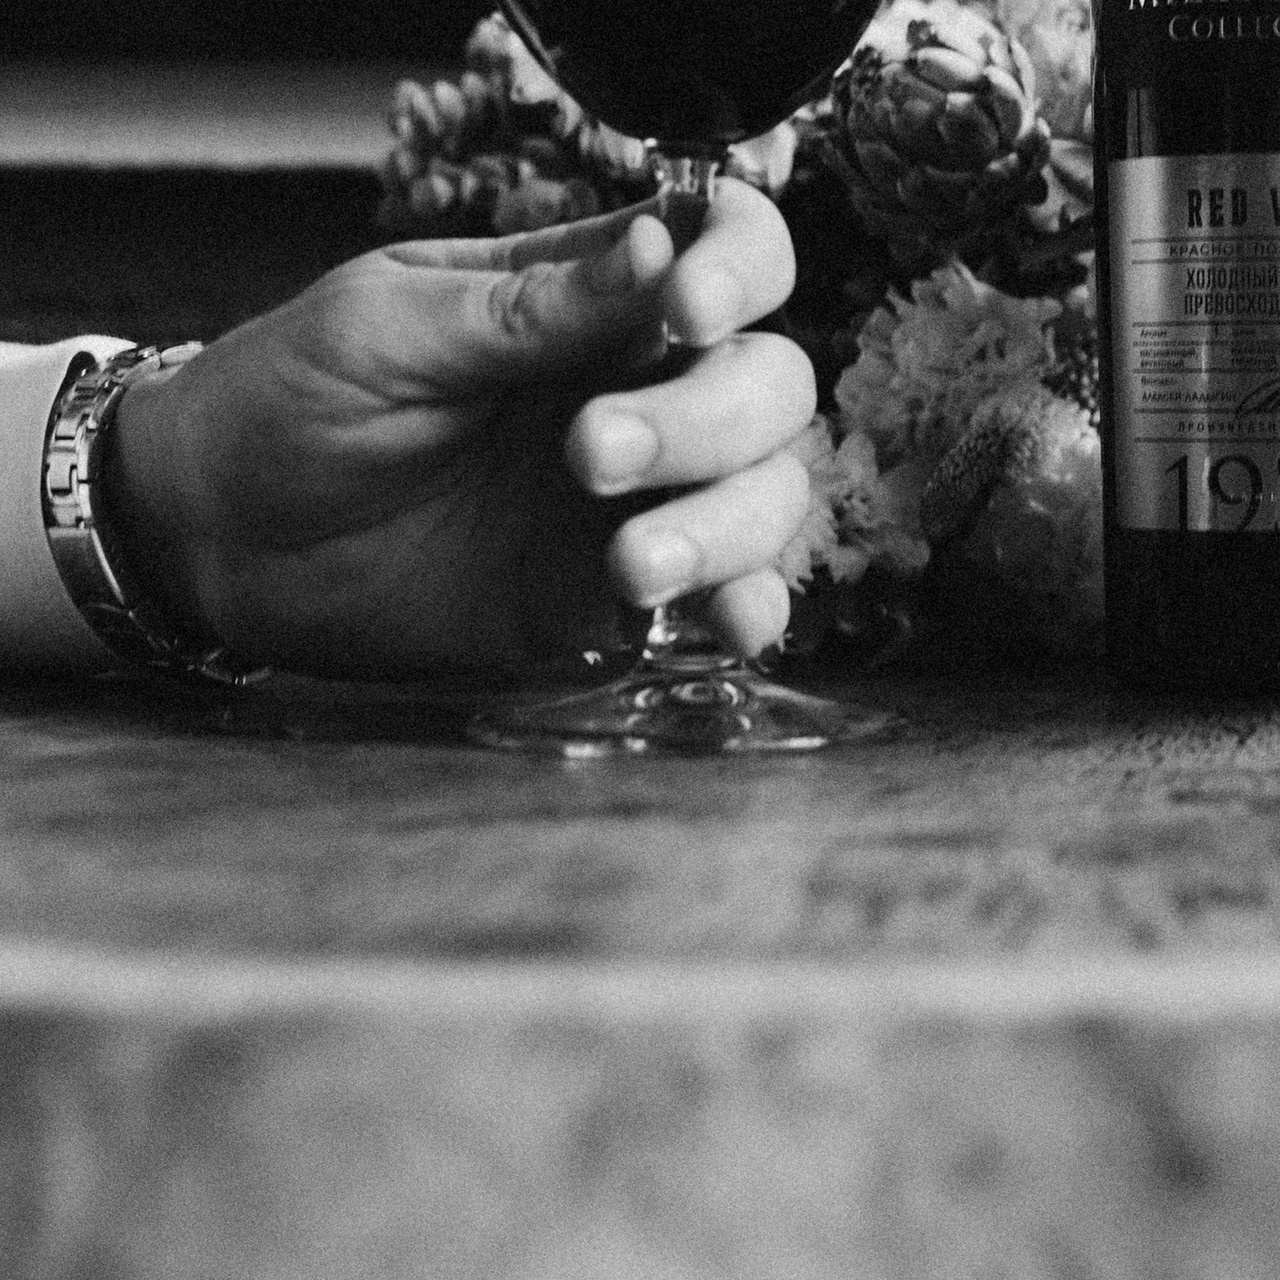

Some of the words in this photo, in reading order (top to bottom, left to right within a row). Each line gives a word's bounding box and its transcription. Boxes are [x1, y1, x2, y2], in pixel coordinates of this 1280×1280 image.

[1187, 187, 1248, 228] RED
[1169, 242, 1246, 257] КРАСНОЕ
[1185, 265, 1279, 290] ХОЛОДНЫЙ
